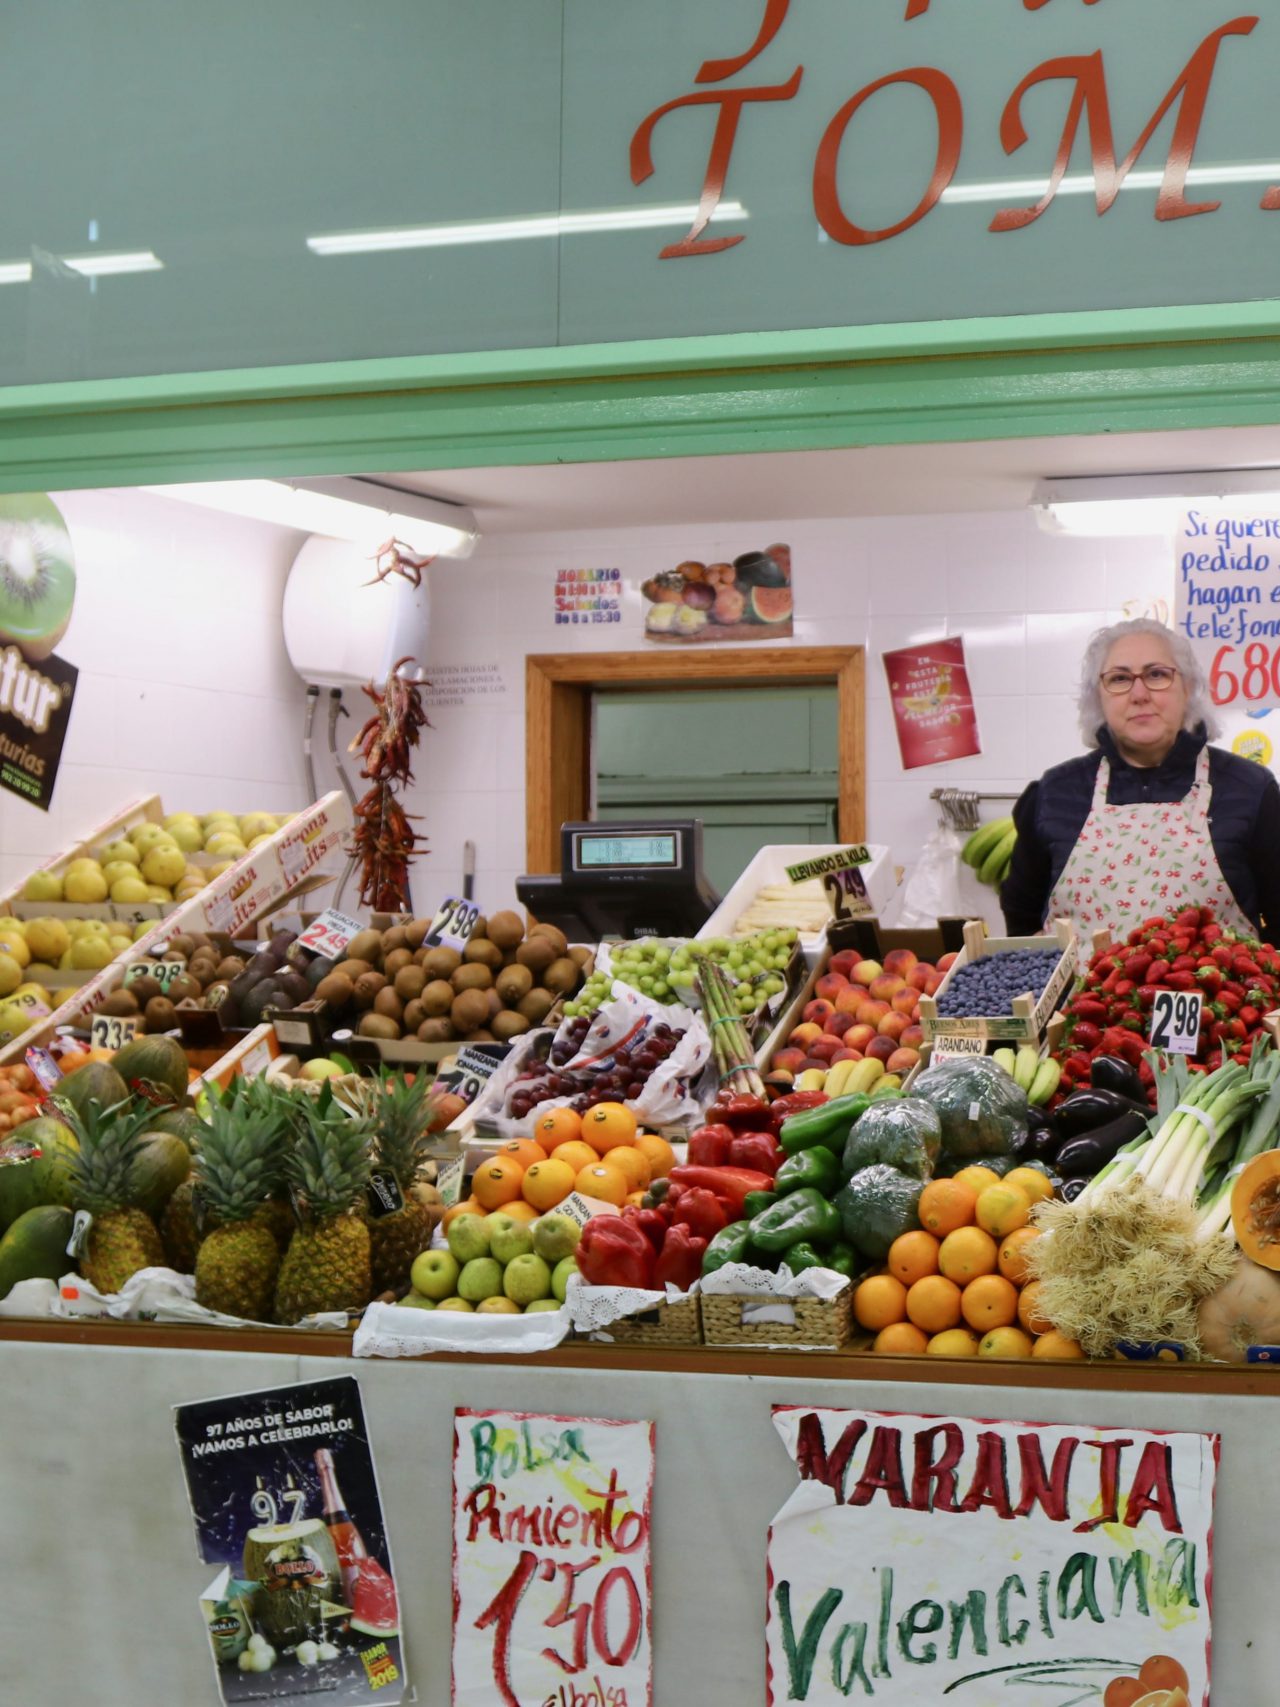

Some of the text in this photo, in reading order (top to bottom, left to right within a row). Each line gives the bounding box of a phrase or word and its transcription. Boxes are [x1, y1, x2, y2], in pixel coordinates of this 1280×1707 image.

[1184, 509, 1209, 538] Si
[1181, 542, 1270, 582] pedido
[1187, 578, 1262, 615] hagan
[0, 650, 60, 732] tur
[787, 846, 869, 882] LLEVANDO EL KILO
[424, 897, 480, 948] 2'98
[1150, 991, 1200, 1049] 2'98
[463, 1048, 499, 1069] MANZANA
[937, 1037, 982, 1054] ARANDANO
[571, 1193, 592, 1220] MANZAN
[206, 1404, 333, 1438] 97 AÑOS DE SABOR
[247, 1435, 259, 1448] A
[260, 1417, 353, 1446] CELEBRARLO!
[274, 1559, 315, 1576] BOLLO
[774, 1537, 1200, 1701] Valenciana
[369, 1664, 400, 1690] 2019
